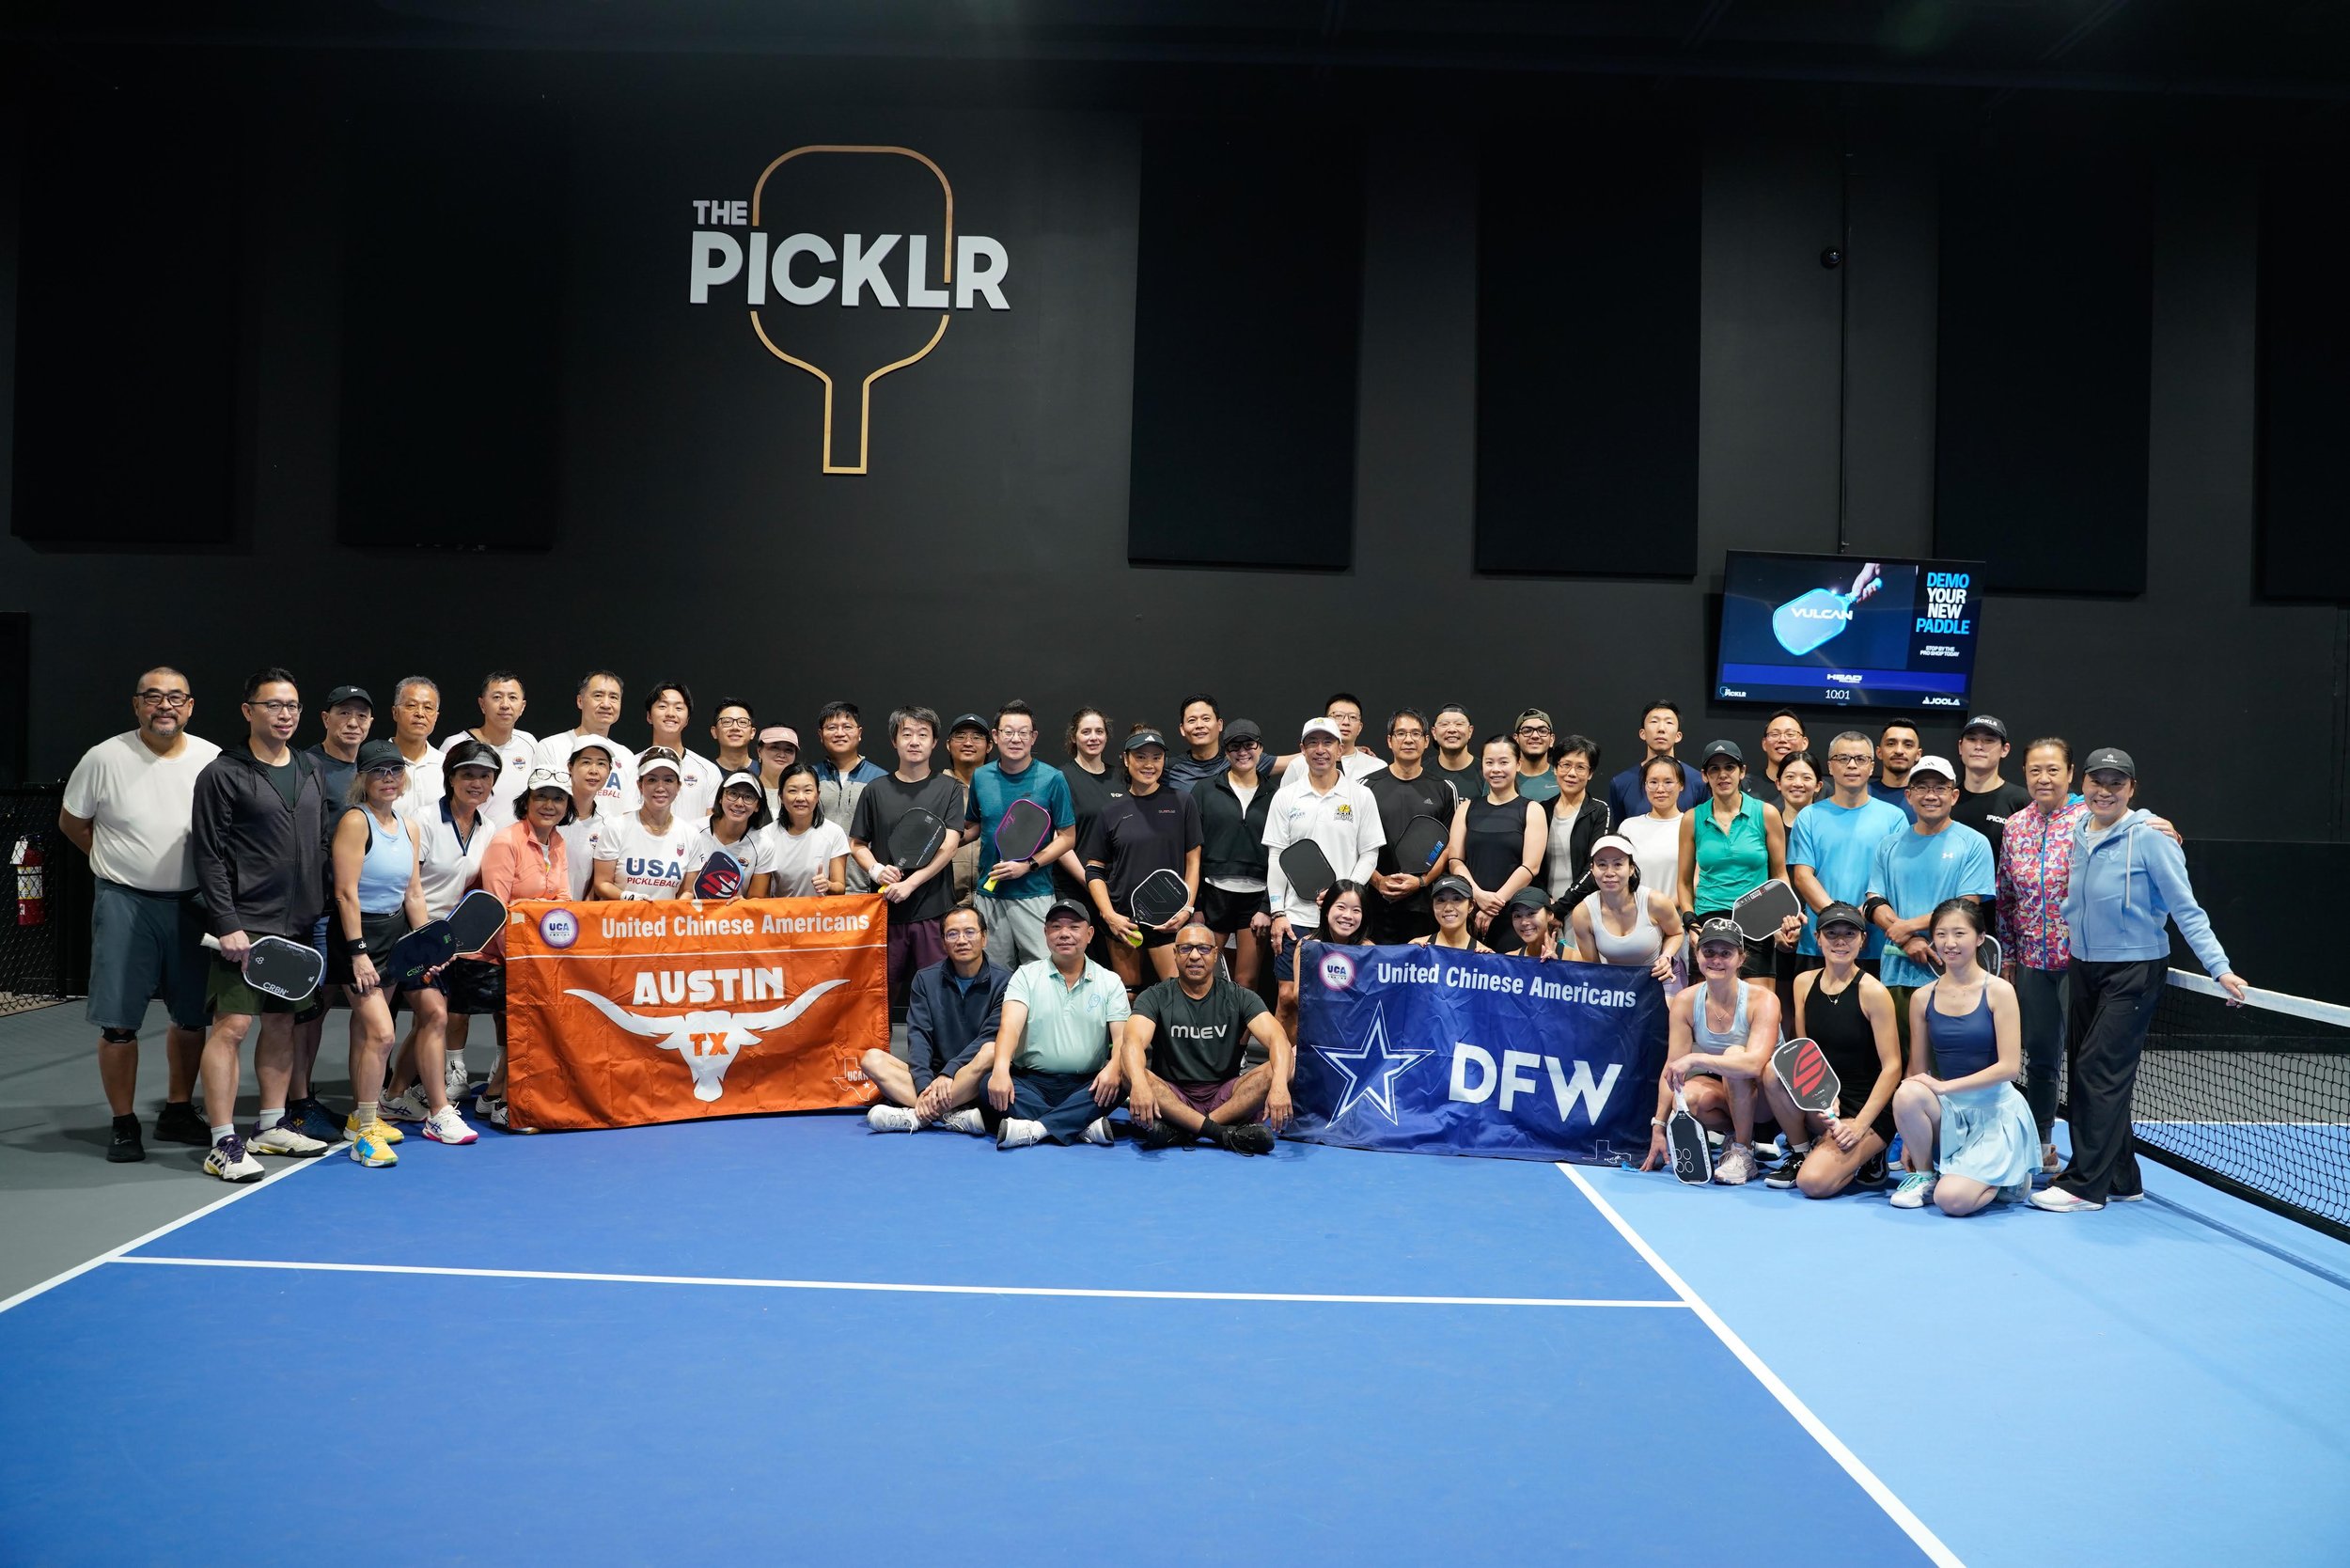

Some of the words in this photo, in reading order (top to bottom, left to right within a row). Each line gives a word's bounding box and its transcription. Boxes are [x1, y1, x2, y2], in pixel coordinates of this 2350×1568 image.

[693, 200, 747, 225] THE
[690, 231, 1010, 309] PICKLR
[1927, 572, 1969, 588] DEMO
[1927, 588, 1966, 604] YOUR
[1791, 607, 1854, 620] VULCAN
[1927, 603, 1963, 619] NEW
[1916, 618, 1970, 635] PADDLE
[1826, 673, 1863, 682] HEAD
[1825, 689, 1850, 699] 10:01
[1929, 697, 1961, 705] JOOLA
[596, 789, 621, 798] EBALL
[626, 857, 682, 880] USA
[627, 876, 680, 888] PICKLEBALL
[549, 922, 570, 932] UCA
[602, 916, 666, 938] United
[673, 915, 755, 937] Chinese
[761, 913, 870, 934] Americans
[1327, 964, 1347, 974] UCA
[633, 966, 786, 1005] AUSTIN
[1377, 963, 1440, 984] United
[1446, 965, 1524, 996] Chinese
[1529, 977, 1637, 1009] Americans
[689, 1032, 729, 1057] TX
[1449, 1042, 1623, 1126] DFW
